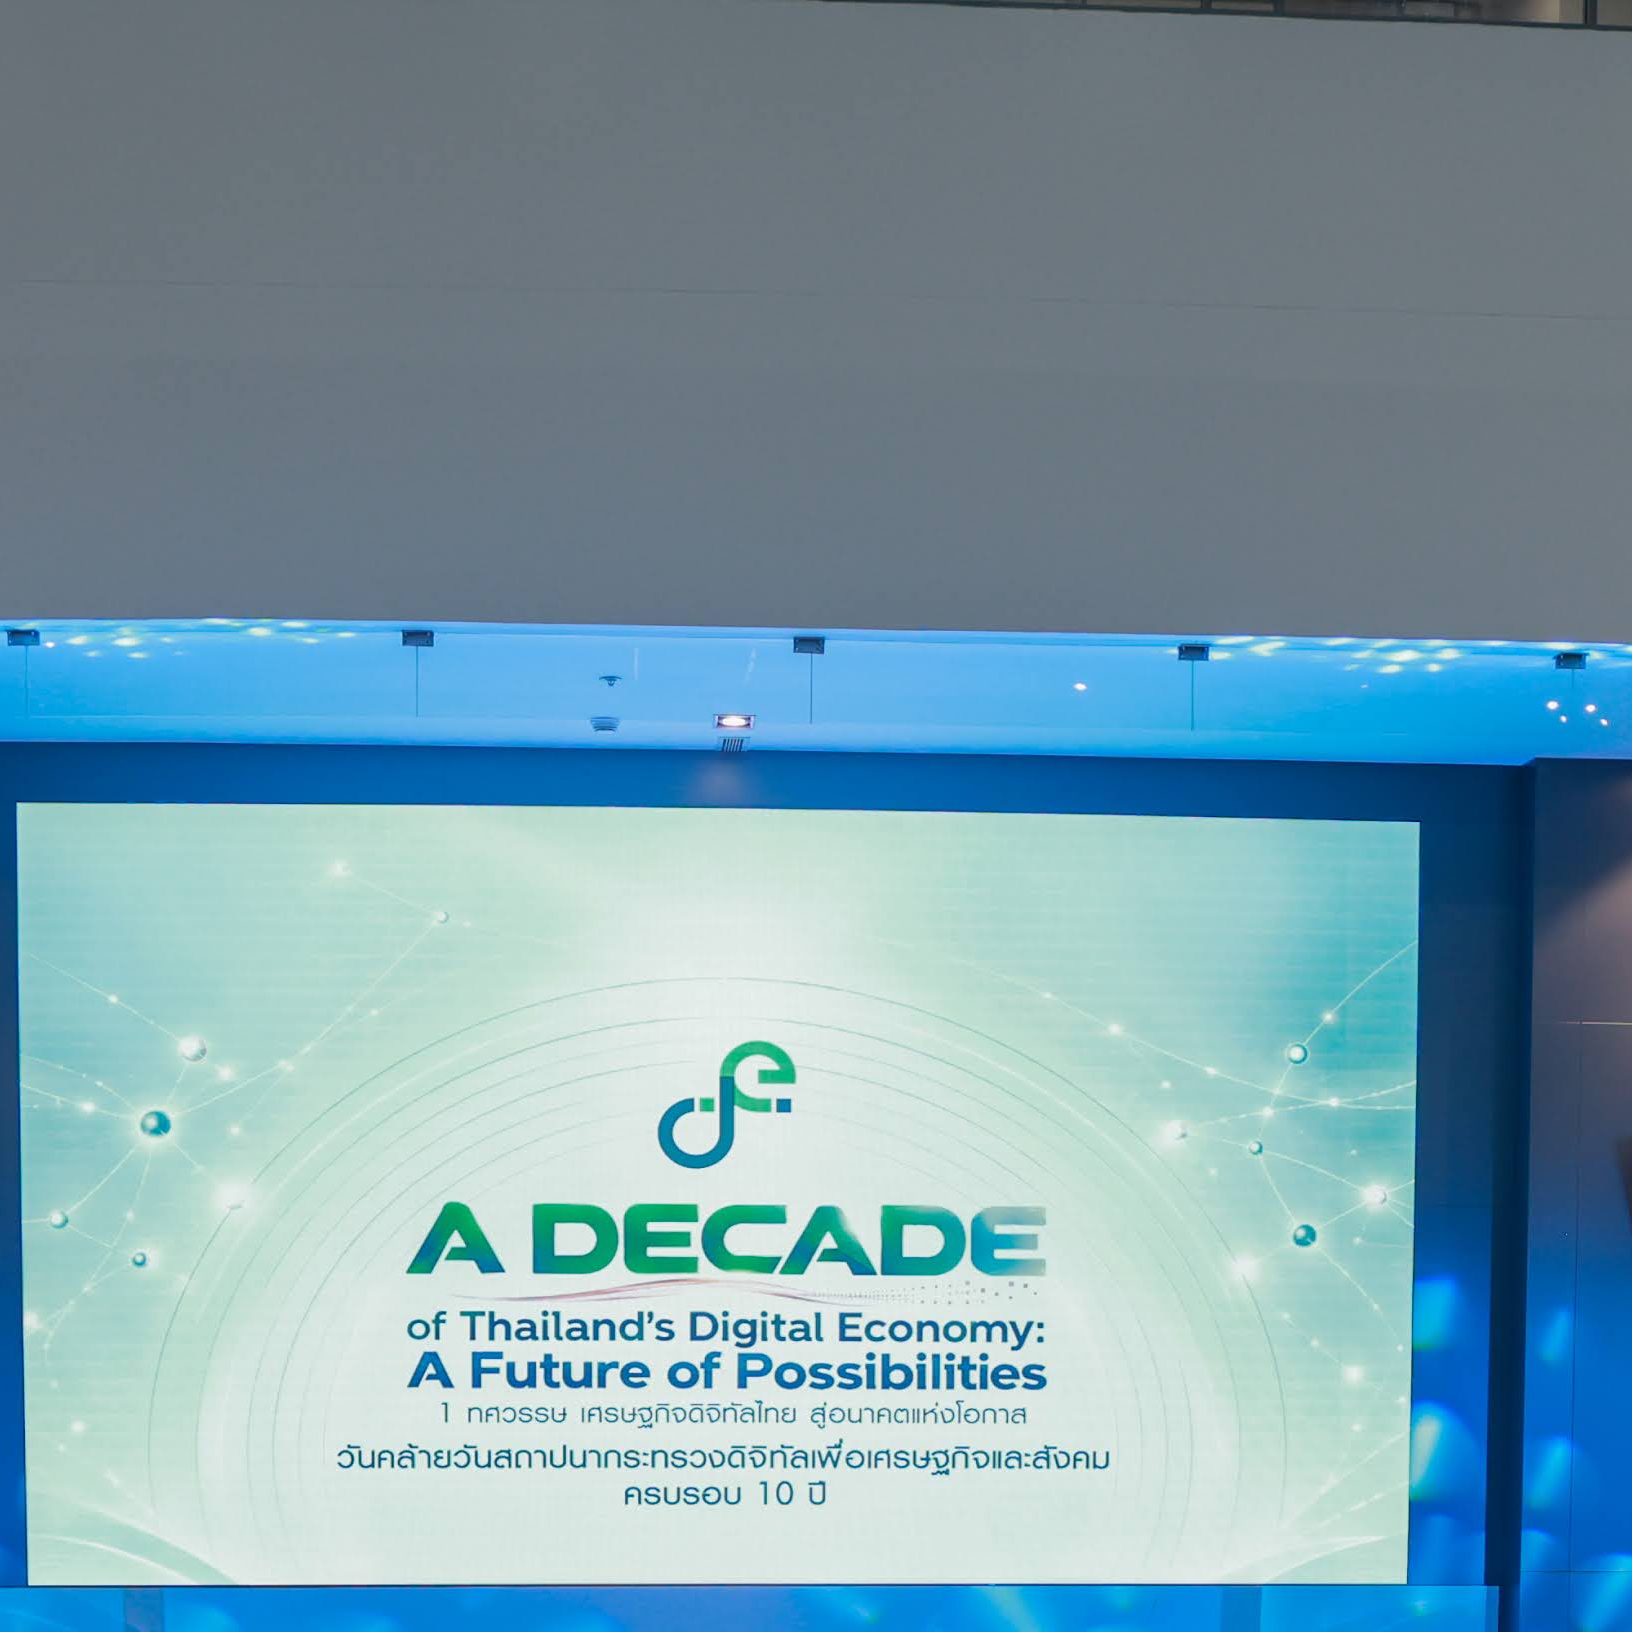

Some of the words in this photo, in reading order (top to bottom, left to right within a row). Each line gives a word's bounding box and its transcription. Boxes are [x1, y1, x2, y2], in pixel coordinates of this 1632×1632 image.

[406, 1201, 506, 1275] A
[532, 1203, 1047, 1277] DECADE
[407, 1310, 447, 1341] of
[459, 1309, 676, 1342] Thailand's
[689, 1309, 824, 1348] Digital
[839, 1311, 1045, 1350] Economy:
[407, 1351, 455, 1389] A
[471, 1352, 651, 1390] Future
[667, 1351, 723, 1390] of
[737, 1352, 1047, 1390] Possibilities
[440, 1402, 449, 1423] 1
[468, 1404, 567, 1424] ทศวรรษ
[582, 1400, 796, 1429] เศรษฐกิจดิจิทัลไทย
[811, 1400, 1027, 1429] สู่อนาคตแห่งโอกาส
[337, 1439, 1110, 1476] วันคล้ายวันสถาปนากระทรวงดิจิทัลเพื่อเศรษฐกิจและสังคม
[625, 1485, 741, 1506] ครบรอบ
[759, 1481, 794, 1506] 10
[808, 1481, 827, 1506] ปี
